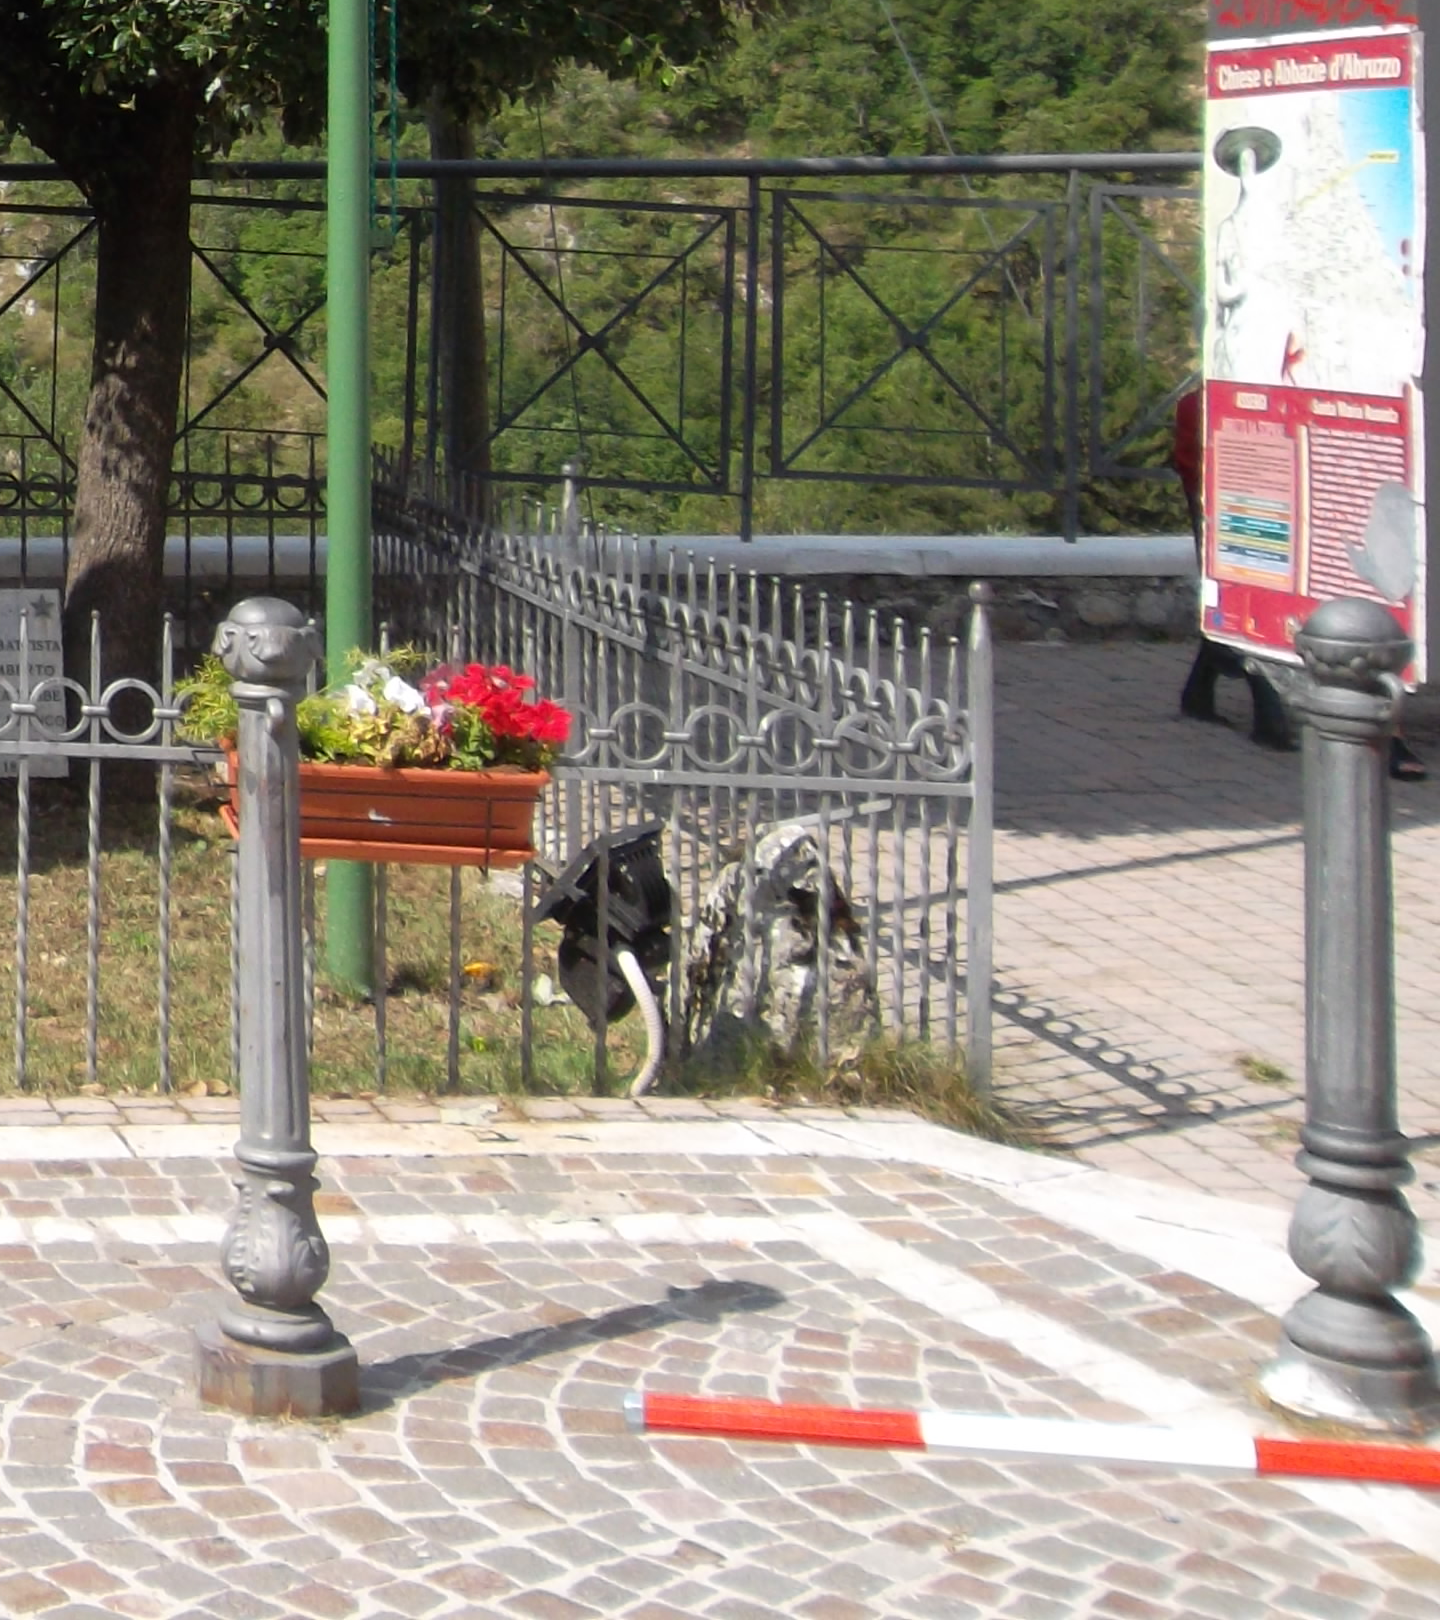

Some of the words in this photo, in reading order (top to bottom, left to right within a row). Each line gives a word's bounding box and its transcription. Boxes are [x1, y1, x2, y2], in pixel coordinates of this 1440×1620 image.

[1218, 63, 1261, 90] Chiese
[1264, 68, 1273, 86] e
[1275, 56, 1326, 85] Abbazie
[1328, 52, 1401, 81] d'Abruzzo
